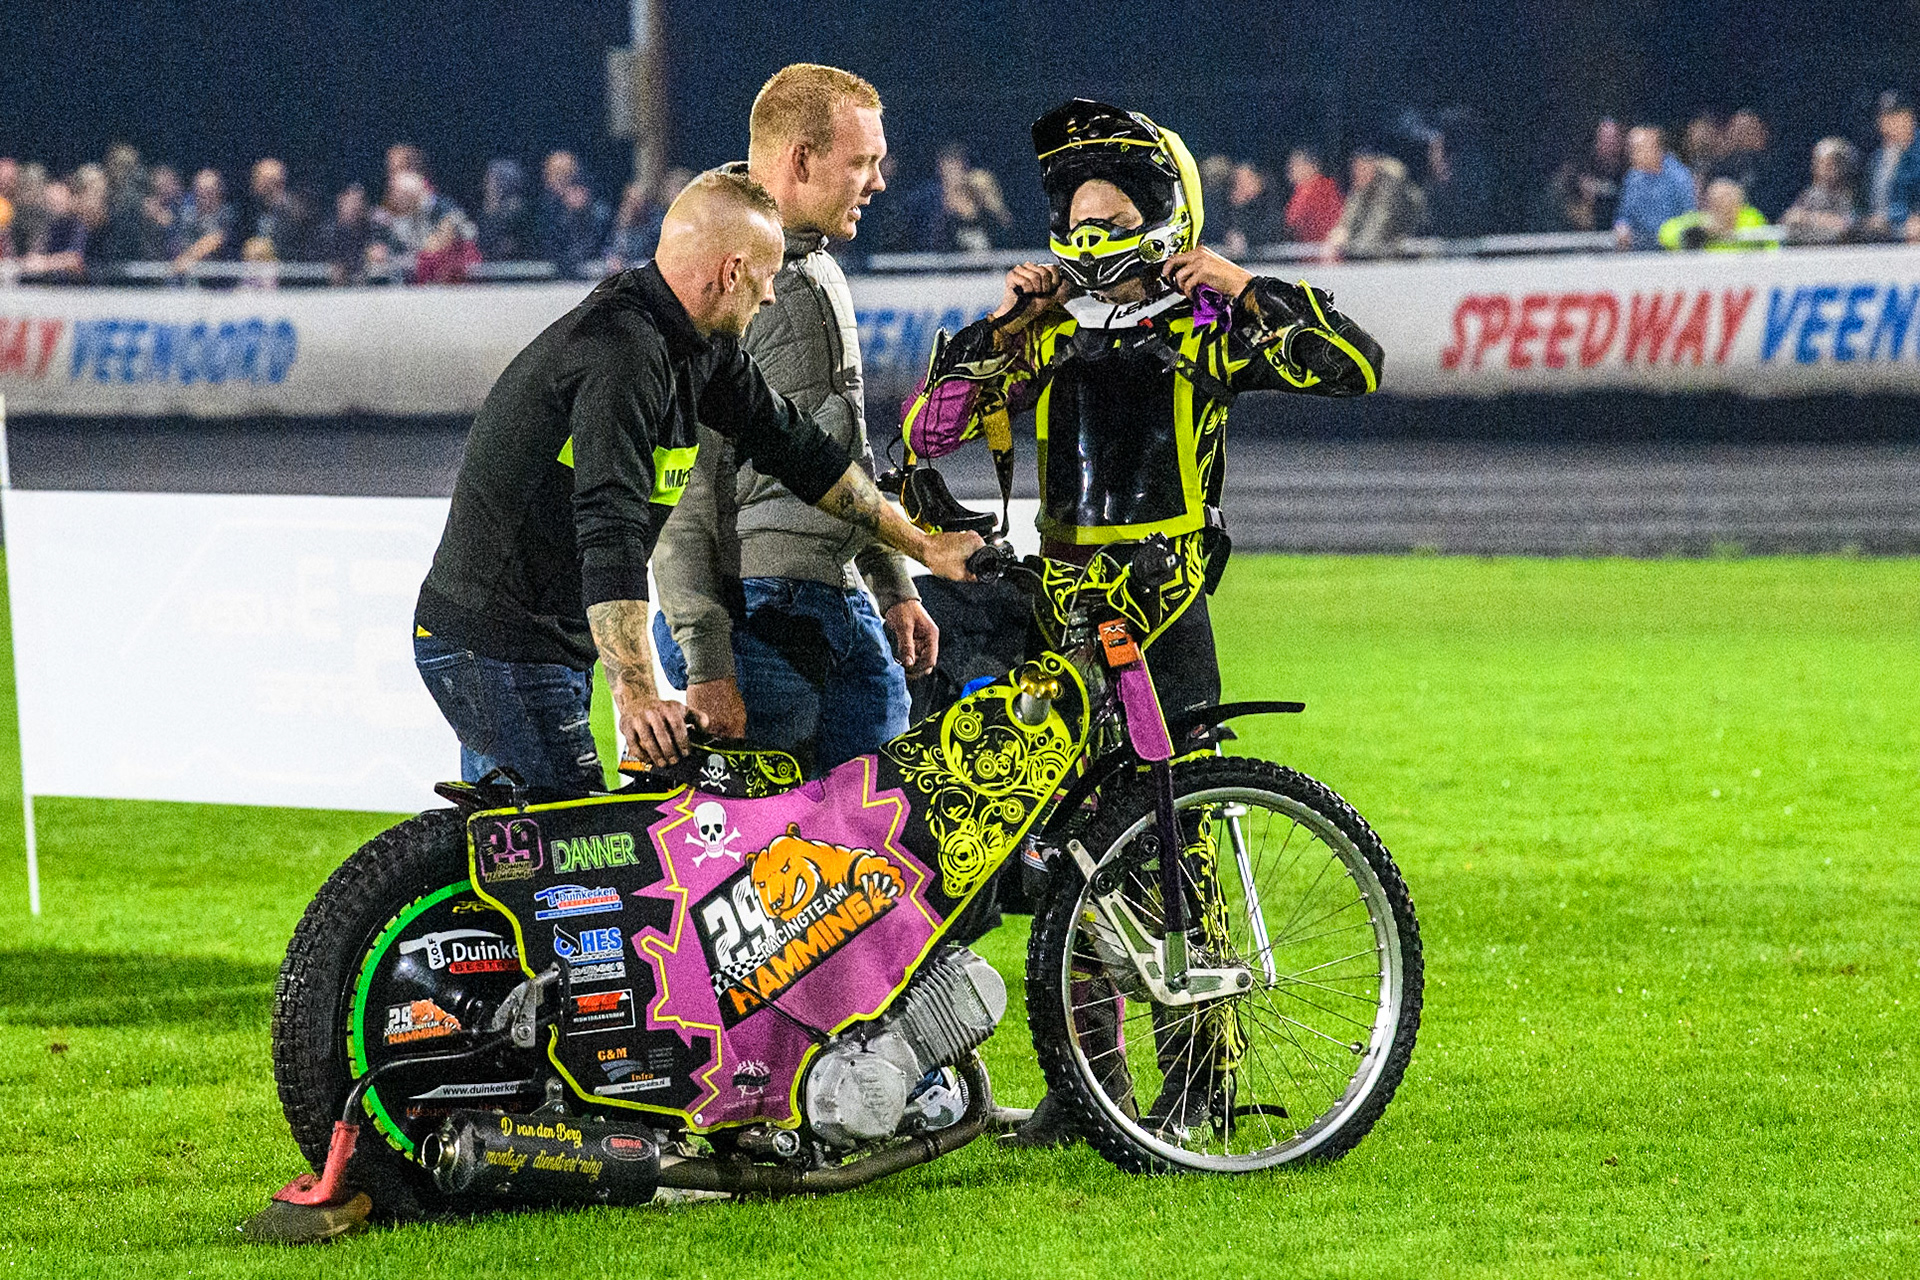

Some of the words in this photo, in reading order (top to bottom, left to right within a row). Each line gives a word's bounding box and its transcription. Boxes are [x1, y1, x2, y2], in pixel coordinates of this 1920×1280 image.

[1442, 286, 1756, 370] SPEEDWAY
[1761, 280, 1920, 363] VEEN
[551, 832, 640, 874] DANNER
[702, 874, 777, 970] 29
[760, 882, 849, 960] RACINGTEAM
[580, 926, 623, 953] HES
[388, 1005, 412, 1030] 29
[597, 1047, 628, 1061] G&M
[631, 1072, 654, 1082] Infra
[501, 1116, 513, 1137] D
[516, 1124, 536, 1137] van
[536, 1122, 556, 1139] den
[556, 1122, 583, 1149] Berg
